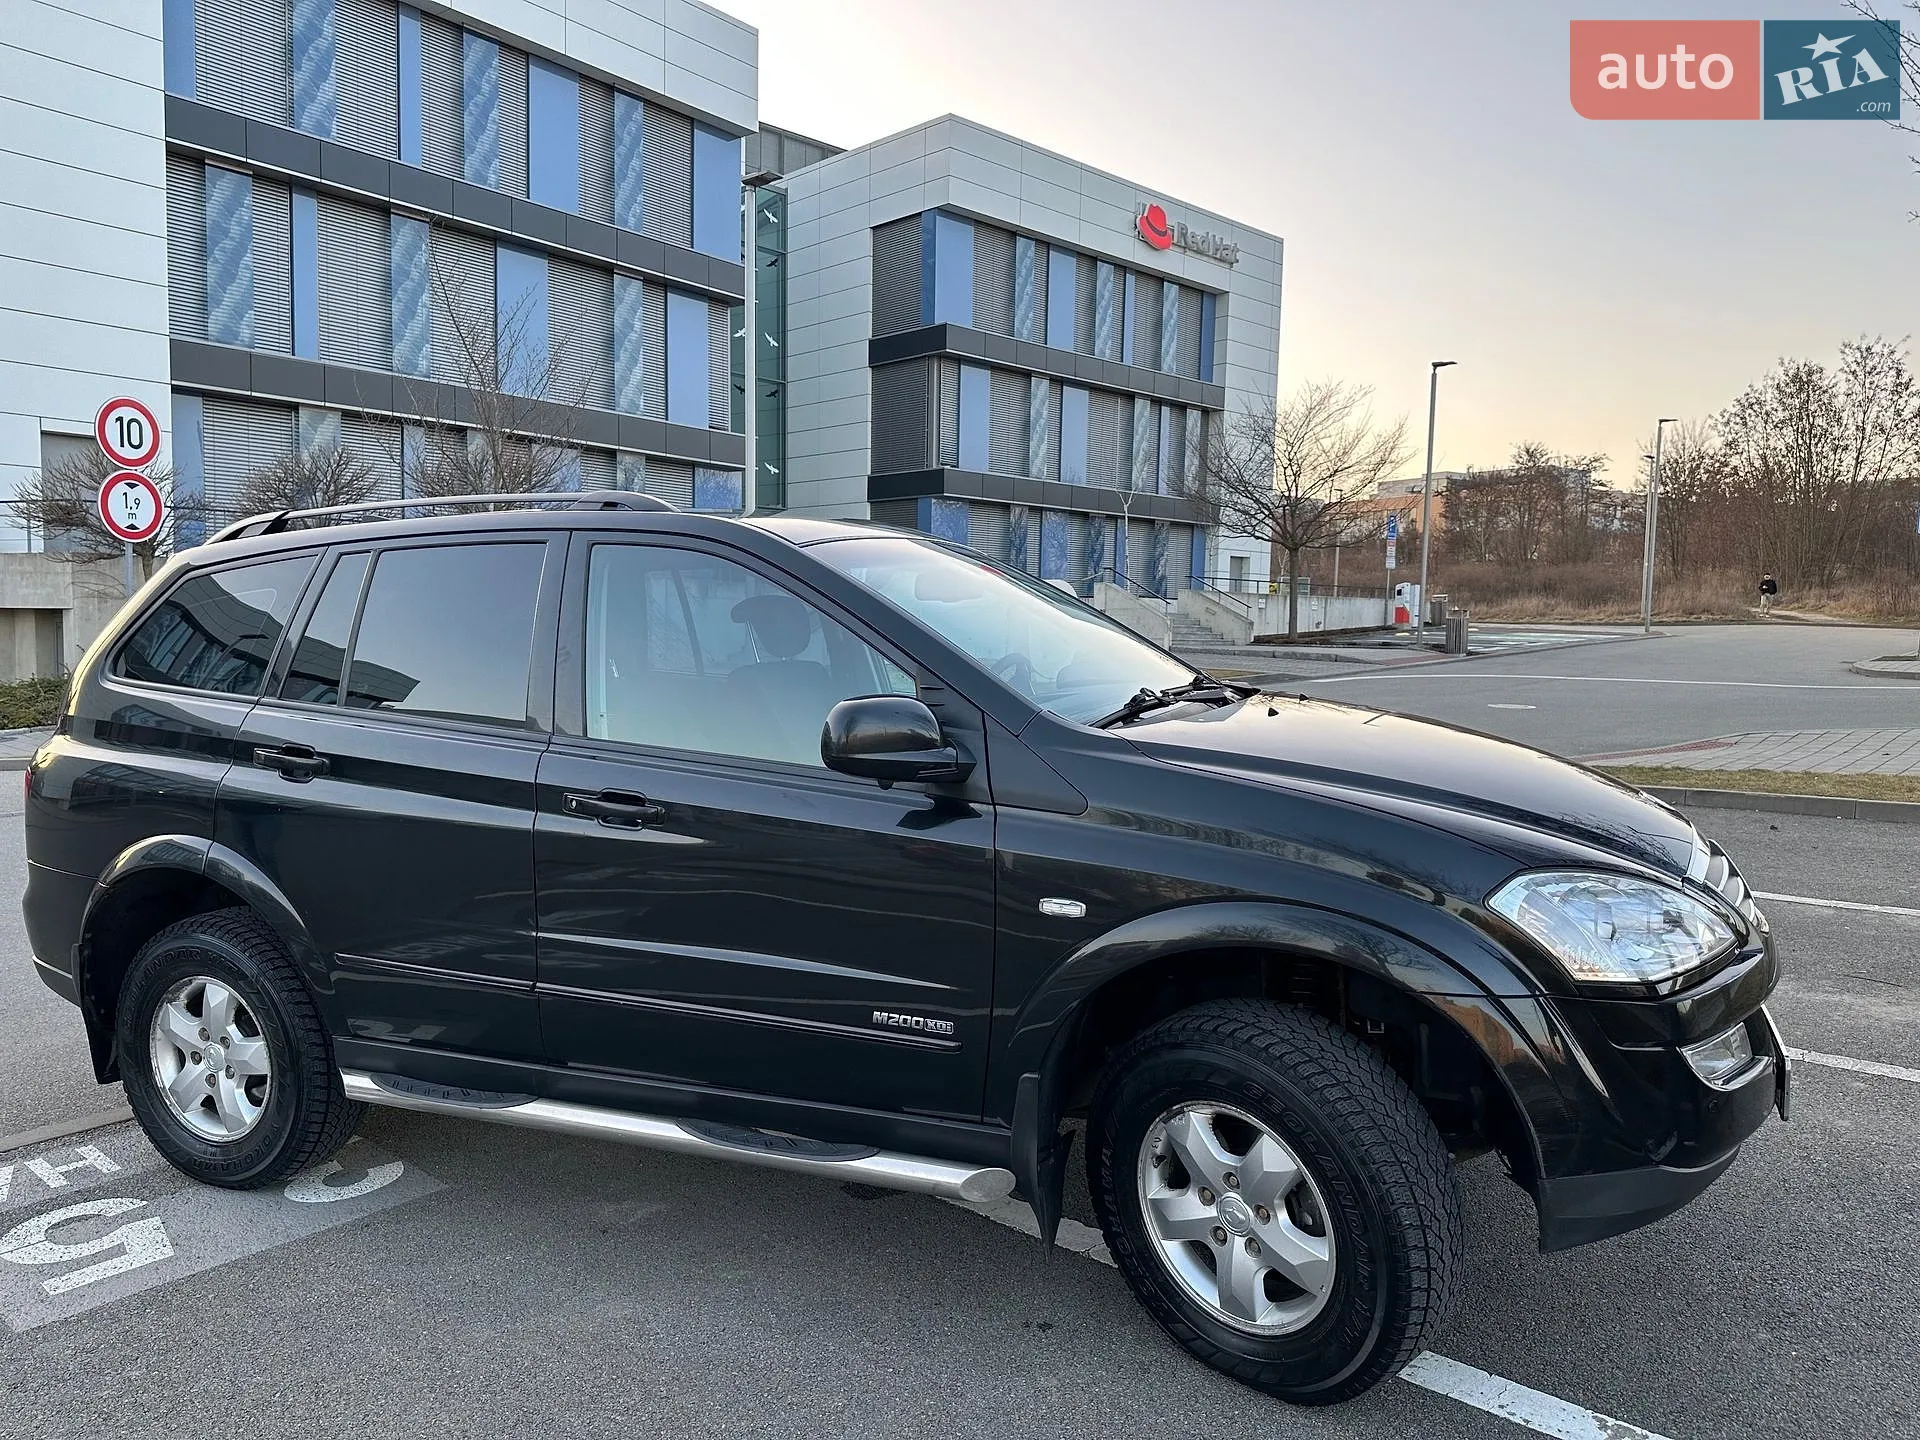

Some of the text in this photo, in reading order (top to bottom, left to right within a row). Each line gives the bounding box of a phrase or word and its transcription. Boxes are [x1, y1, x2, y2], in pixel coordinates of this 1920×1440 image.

[1175, 221, 1240, 264] Red Hat
[114, 415, 143, 450] 10
[872, 1011, 925, 1030] M200
[191, 1121, 281, 1175] YOKOHAMA
